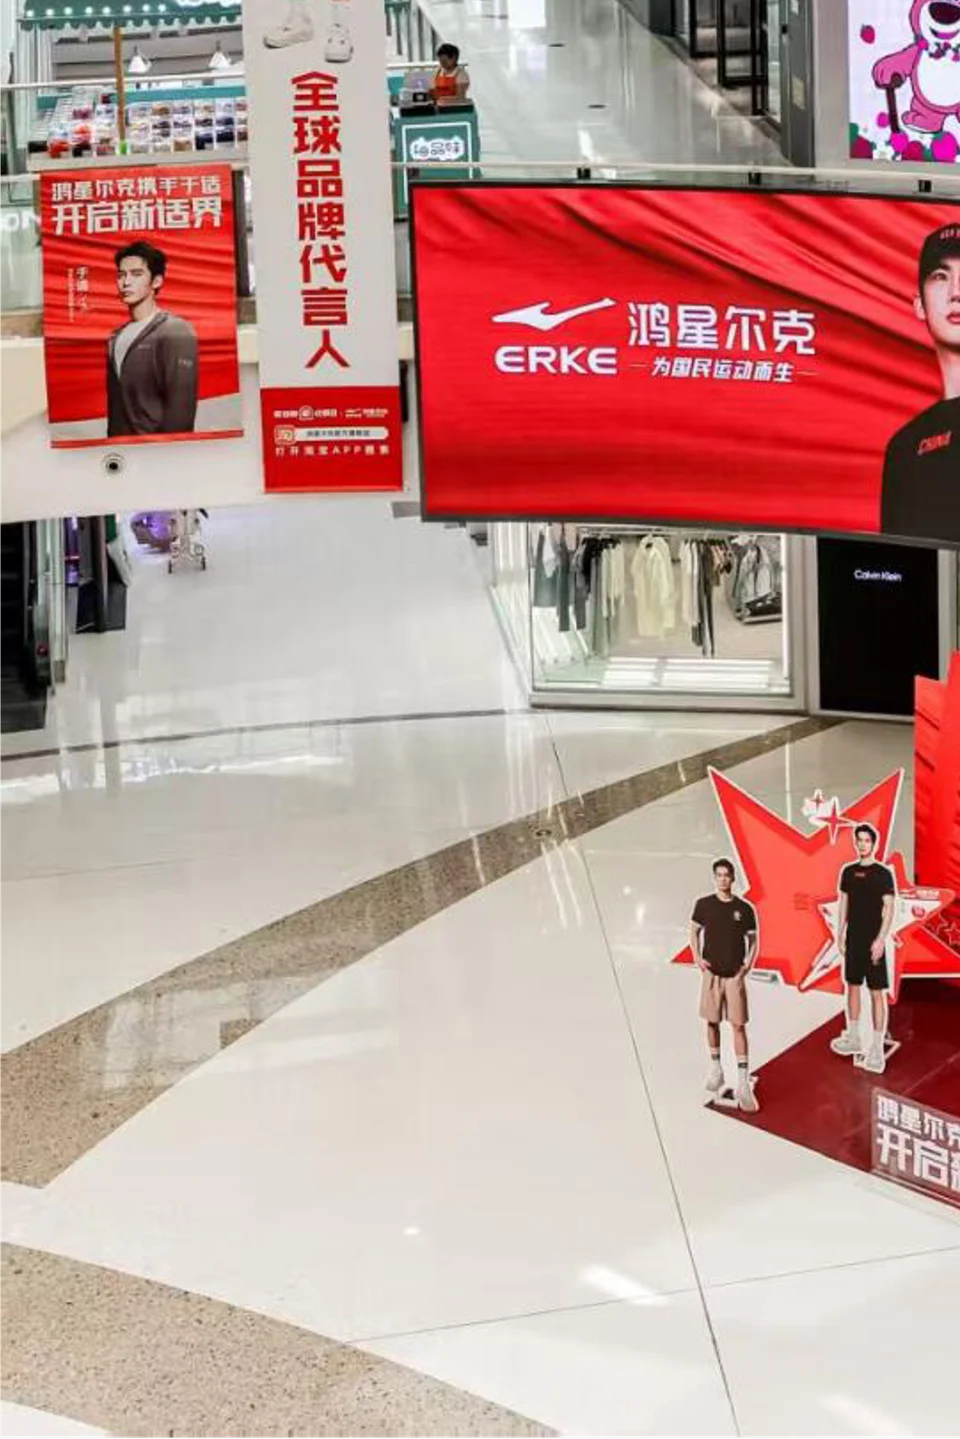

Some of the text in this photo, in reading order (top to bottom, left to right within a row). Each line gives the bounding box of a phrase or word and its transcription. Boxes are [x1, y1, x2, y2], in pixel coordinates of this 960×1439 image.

[52, 175, 221, 202] 鸿星尔克携手于适
[291, 71, 350, 368] 全球品牌代言人
[627, 301, 817, 355] 鸿星尔克
[494, 345, 617, 375] ERKE
[650, 356, 794, 383] 为国民运动而生
